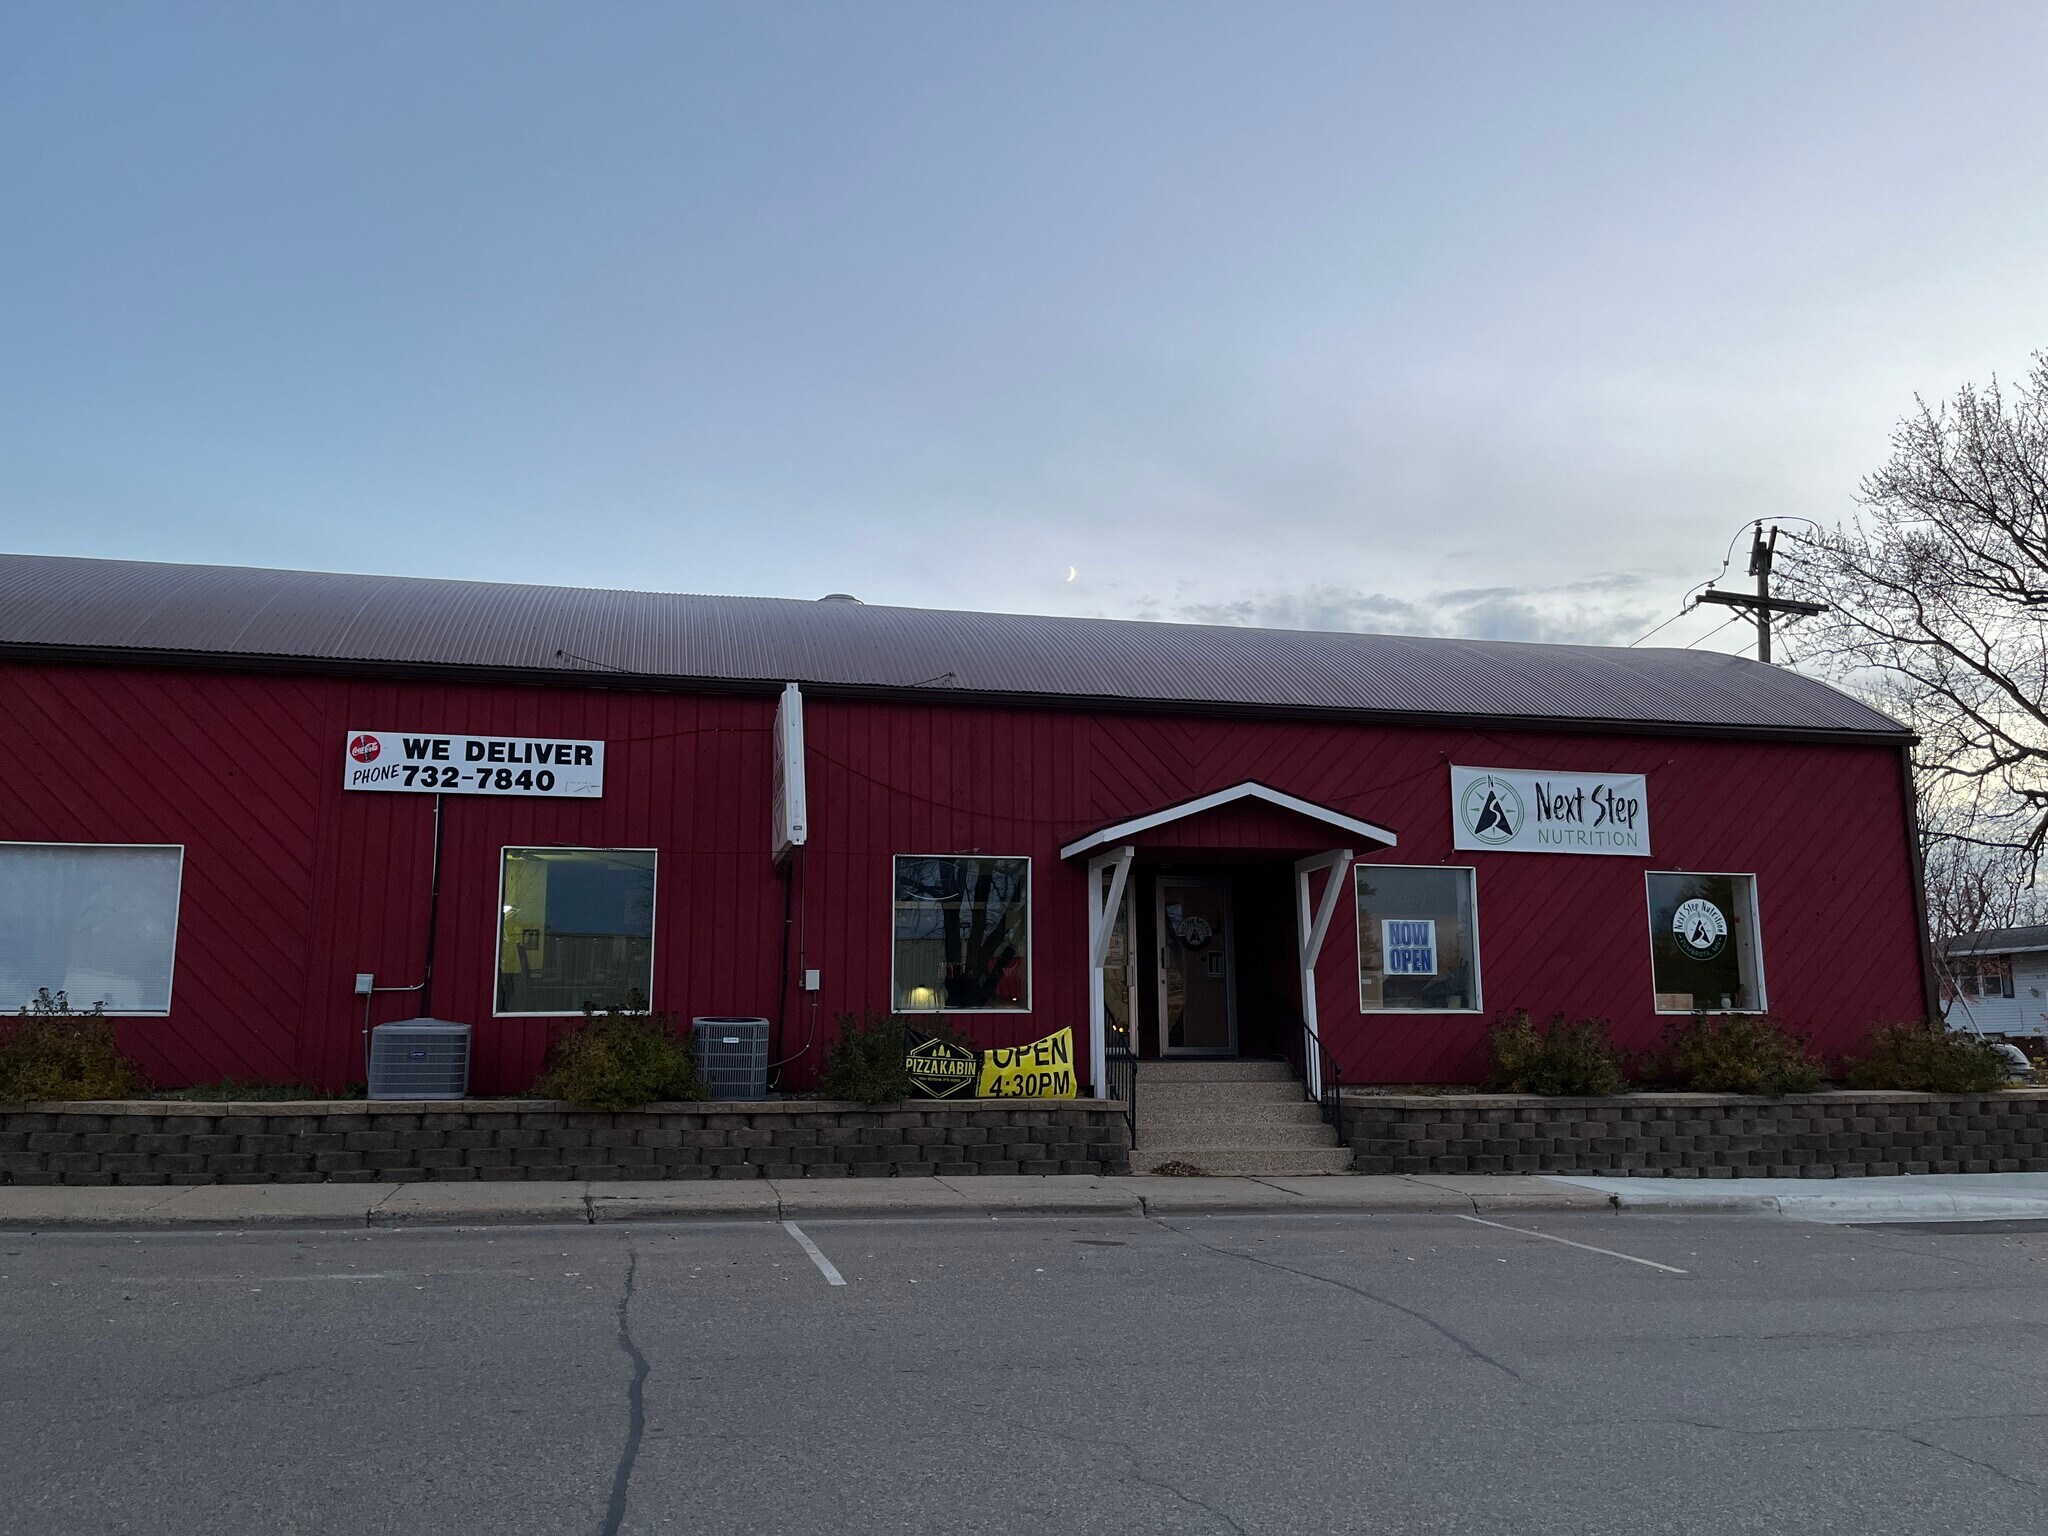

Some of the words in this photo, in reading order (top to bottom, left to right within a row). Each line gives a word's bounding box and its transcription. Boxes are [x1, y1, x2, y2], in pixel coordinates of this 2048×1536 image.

[402, 738, 450, 760] WE
[465, 740, 593, 766] DELIVER
[353, 763, 400, 785] PHONE
[402, 765, 555, 791] 732-7840
[1535, 781, 1585, 823] Next
[1591, 784, 1638, 829] Step
[1538, 829, 1638, 847] NUTRITION
[1674, 911, 1687, 930] Next
[1683, 902, 1699, 915] Step
[1701, 901, 1724, 933] Nutrition
[1388, 921, 1429, 947] NOW
[1389, 947, 1432, 973] OPEN
[989, 1071, 1070, 1097] 4:30PM
